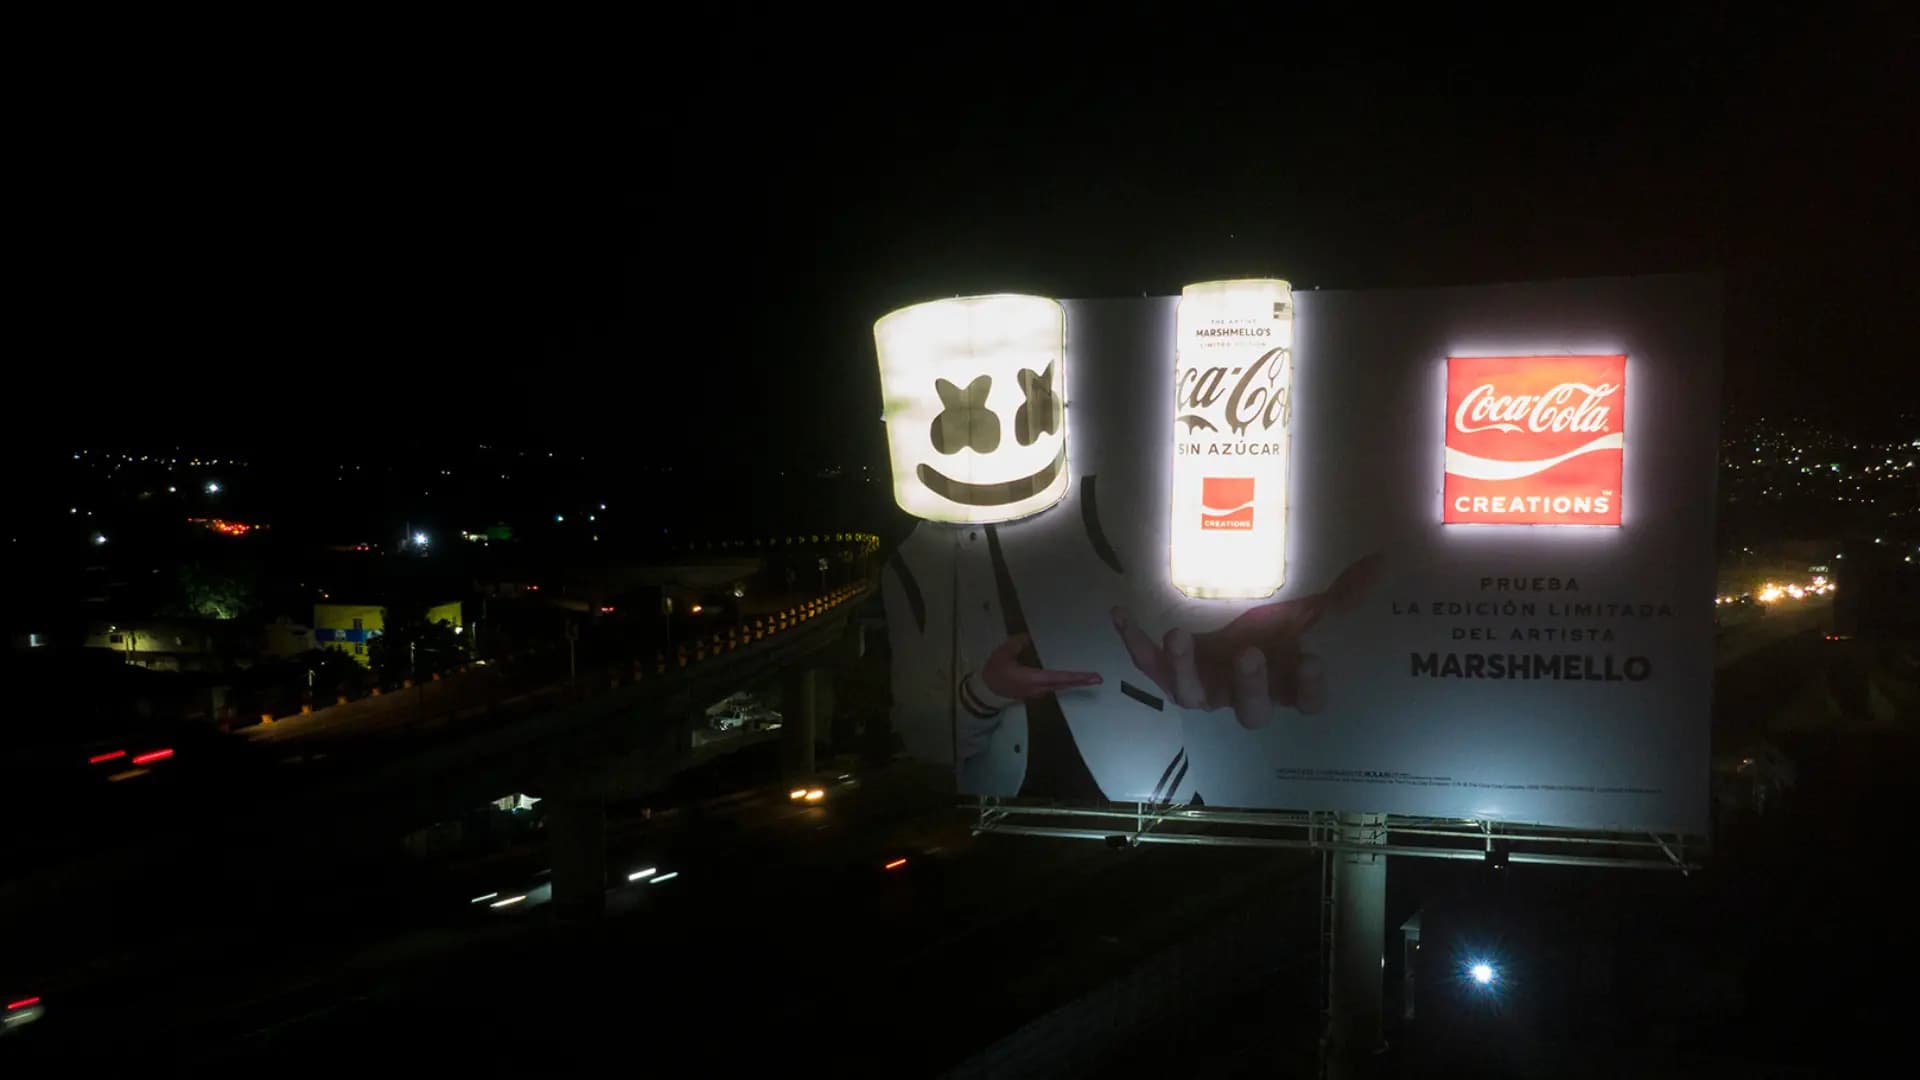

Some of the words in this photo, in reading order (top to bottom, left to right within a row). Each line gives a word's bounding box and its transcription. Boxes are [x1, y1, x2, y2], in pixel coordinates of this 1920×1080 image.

[1196, 327, 1272, 337] MARSHMELLO'S
[1178, 443, 1201, 456] SIN
[1207, 440, 1280, 456] AZÚCAR
[1204, 520, 1251, 528] CREATIONS
[1480, 577, 1580, 592] PRUEBA
[1391, 601, 1421, 615] LA
[1432, 599, 1536, 617] EDICIÓN
[1548, 602, 1673, 618] LIMITADA
[1452, 627, 1497, 641] DEL
[1510, 628, 1616, 642] ARTISTA
[1410, 651, 1652, 682] MARSHMELLO
